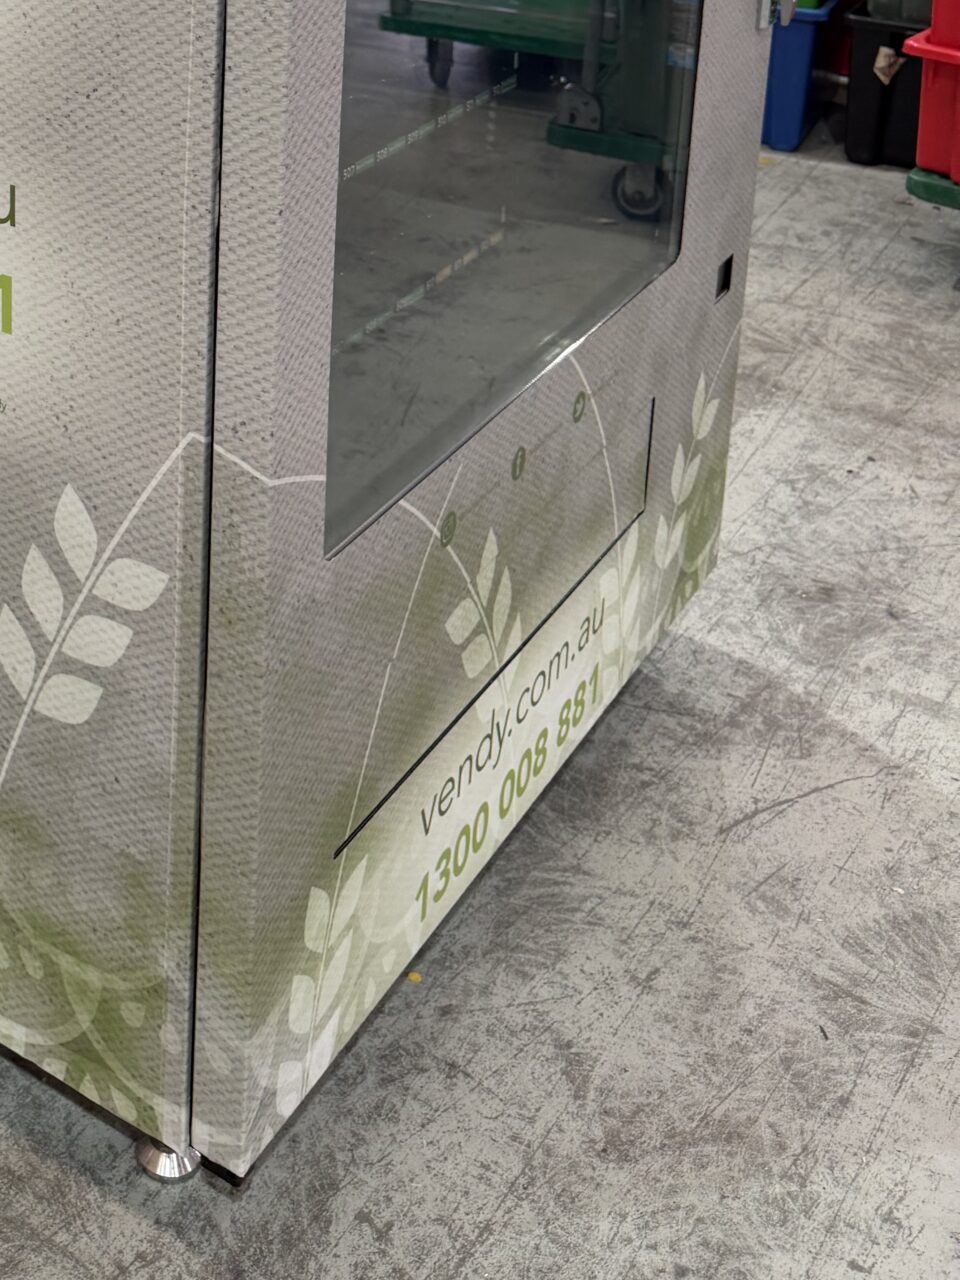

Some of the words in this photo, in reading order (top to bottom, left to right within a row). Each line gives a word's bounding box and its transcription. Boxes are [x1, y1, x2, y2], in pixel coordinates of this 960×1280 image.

[415, 801, 490, 923] 1300
[498, 727, 549, 820] 008
[556, 662, 602, 748] 881
[421, 597, 605, 836] vendy.com.au
